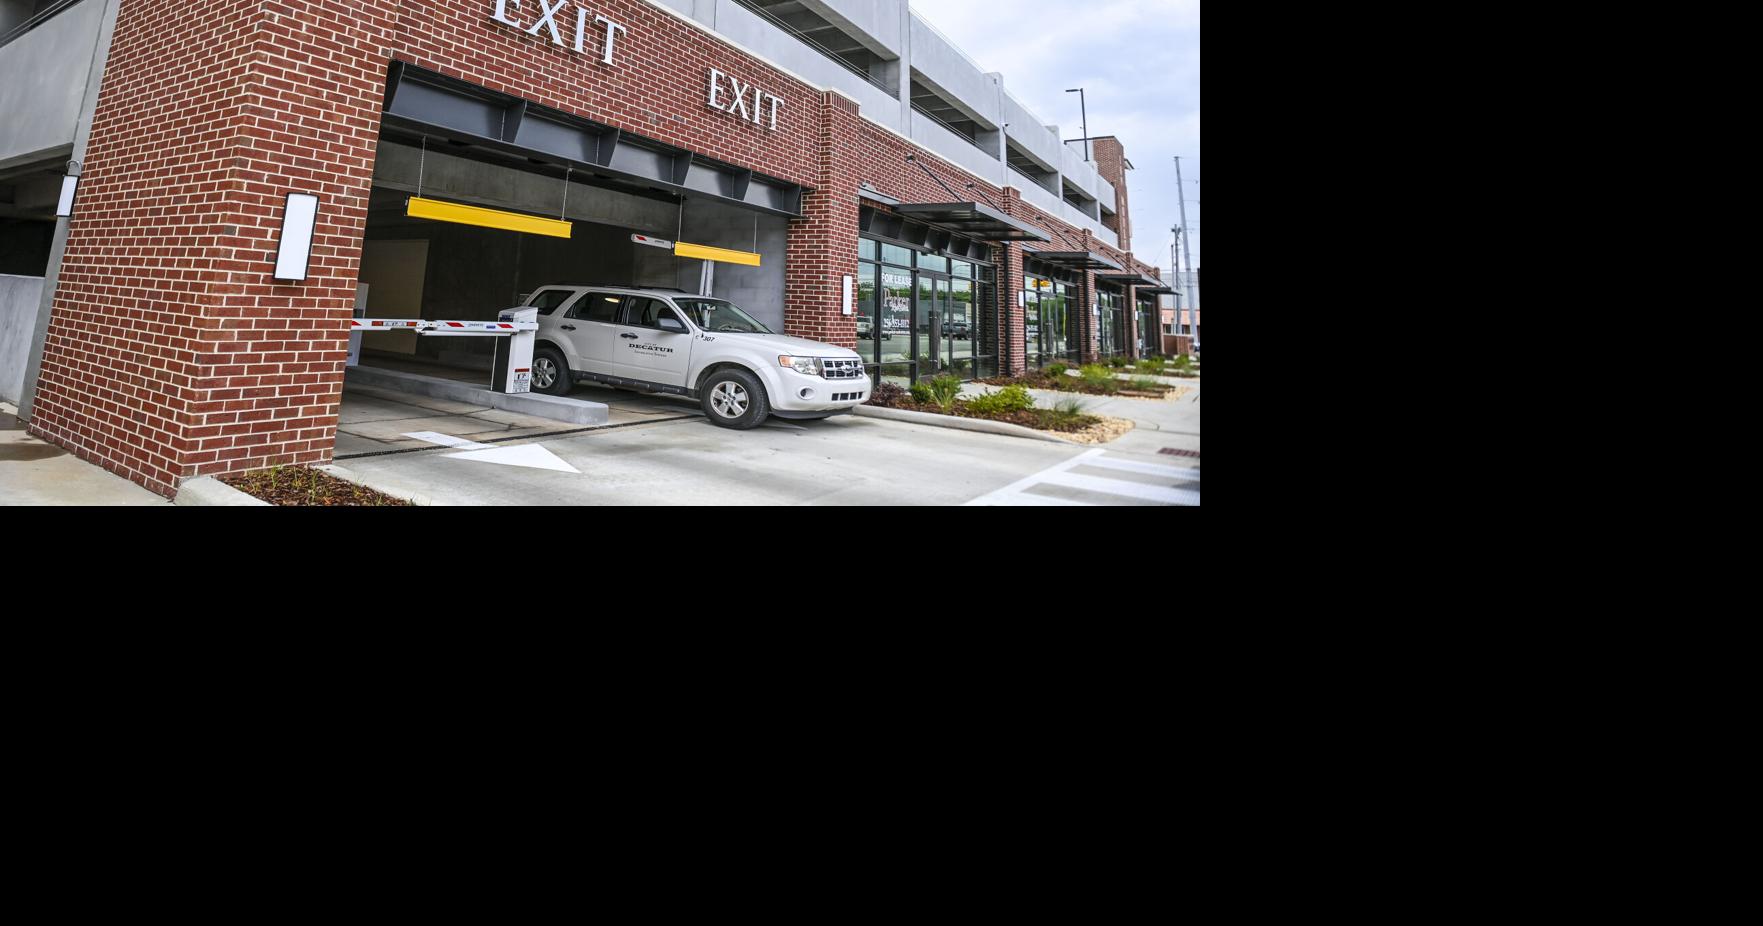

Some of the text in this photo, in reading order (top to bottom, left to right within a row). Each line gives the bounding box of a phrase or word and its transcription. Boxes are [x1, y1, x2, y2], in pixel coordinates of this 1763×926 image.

[489, 0, 626, 66] EXIT
[707, 68, 784, 131] EXIT
[881, 272, 912, 287] FOR LEASE
[883, 287, 910, 307] Parker
[629, 343, 673, 353] DECATUR
